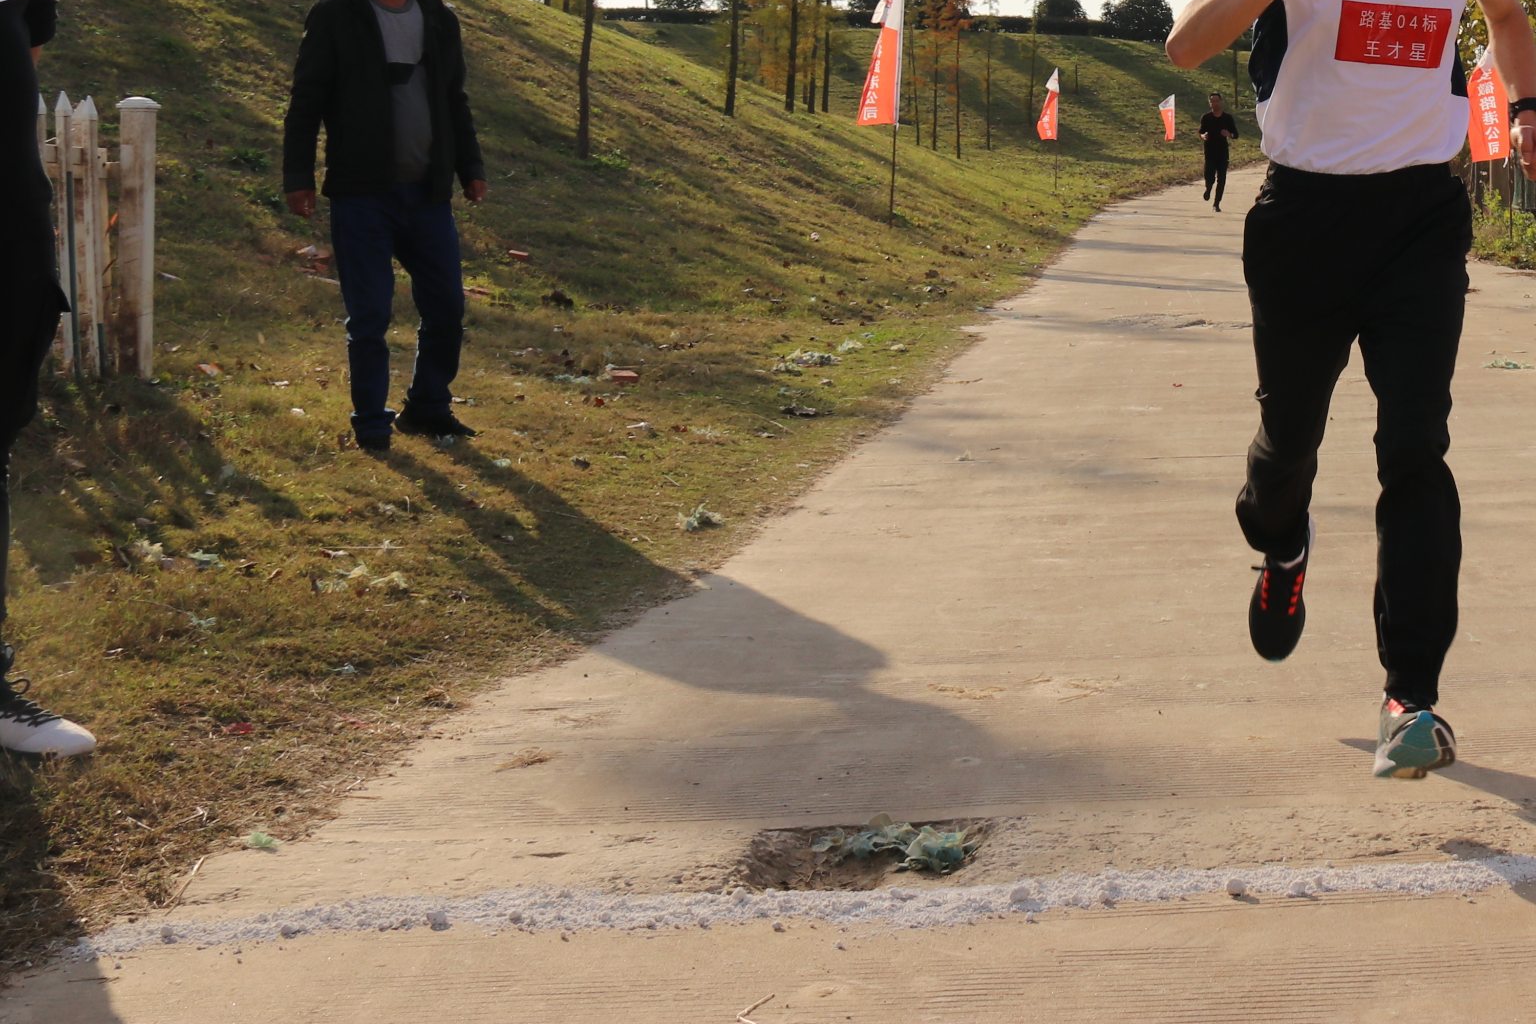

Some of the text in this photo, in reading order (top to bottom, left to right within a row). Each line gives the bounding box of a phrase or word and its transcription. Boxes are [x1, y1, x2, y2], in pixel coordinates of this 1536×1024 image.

[1359, 10, 1437, 33] 路基04标
[1363, 40, 1427, 62] 王才星
